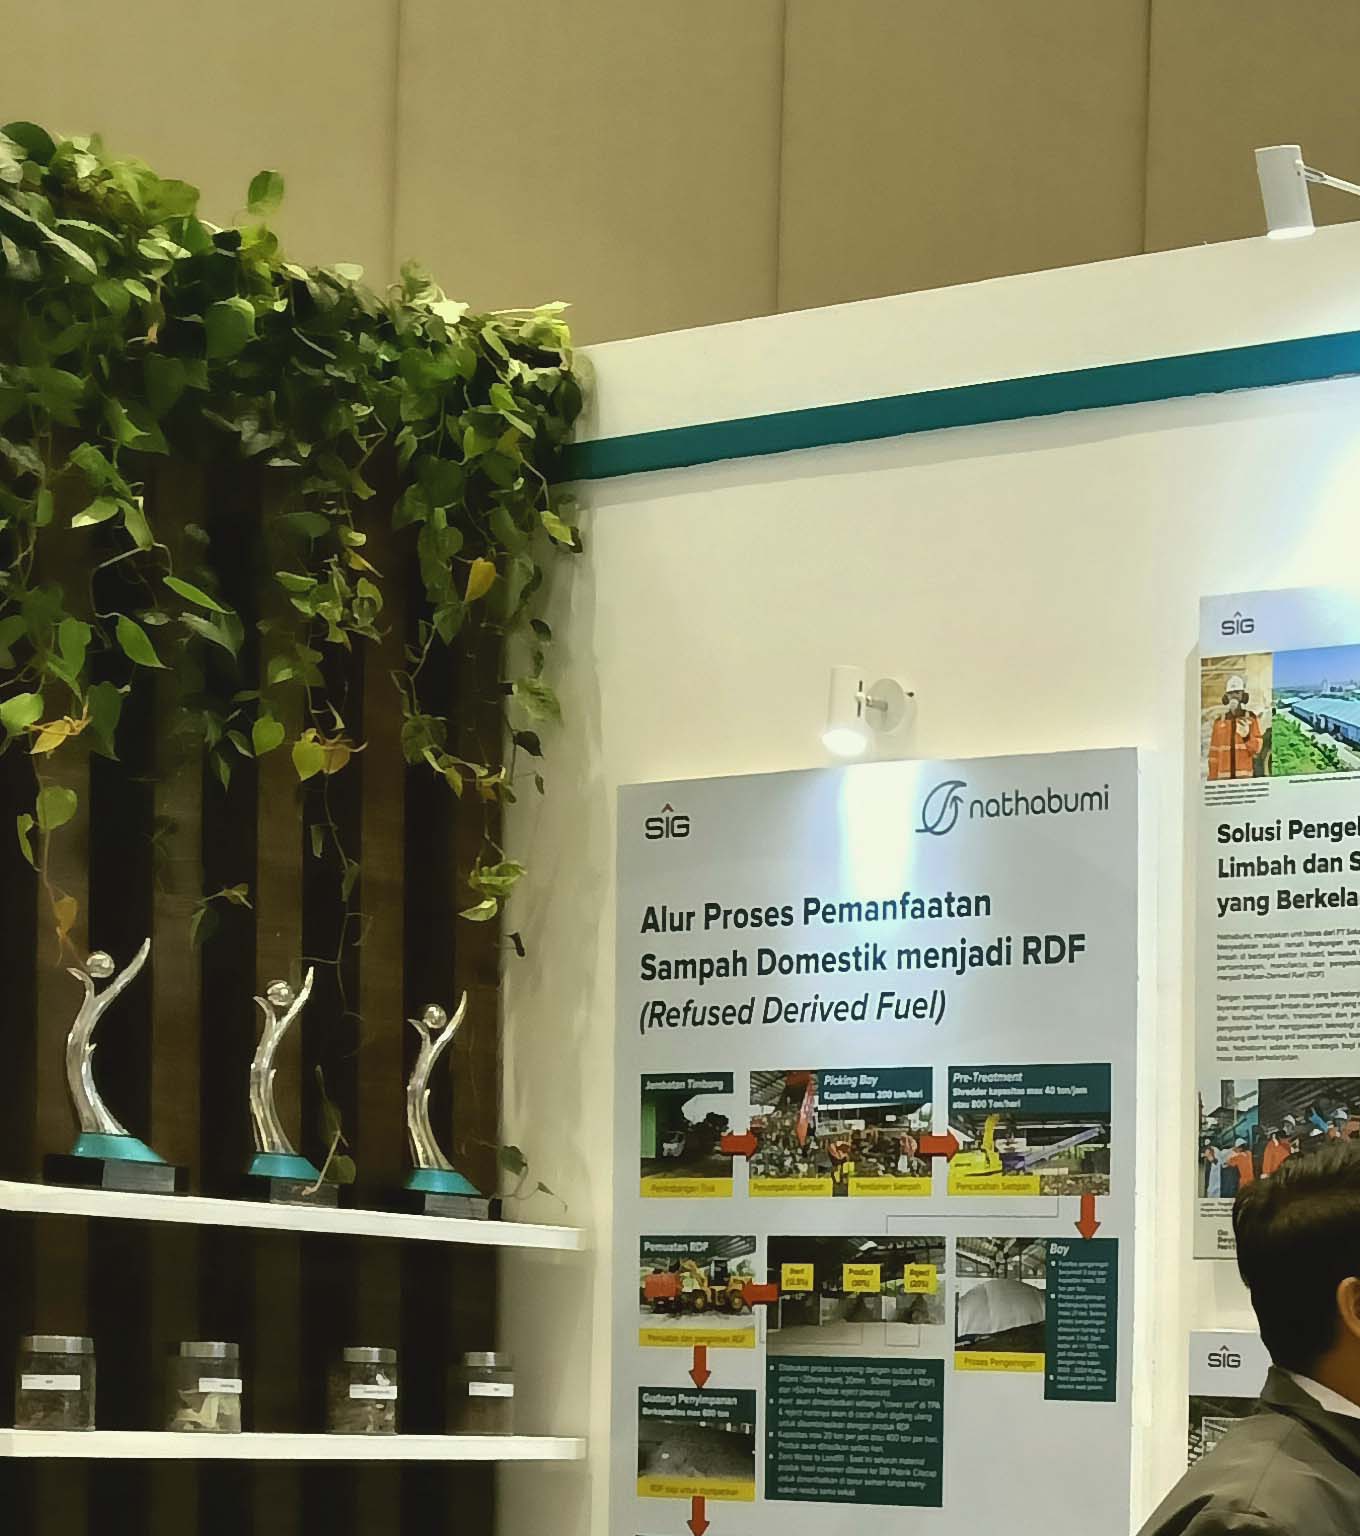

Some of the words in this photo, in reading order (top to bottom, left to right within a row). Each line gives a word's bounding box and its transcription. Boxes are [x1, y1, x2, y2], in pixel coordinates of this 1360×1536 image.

[1221, 612, 1254, 635] SIG
[970, 785, 1110, 820] nathabumi
[645, 804, 690, 840] SIG
[1217, 819, 1281, 843] Solusi
[1218, 853, 1296, 878] Limbah
[1303, 851, 1342, 874] dan
[641, 905, 695, 933] Alur
[704, 902, 794, 931] Proses
[803, 892, 991, 925] Pemanfaatan
[1217, 891, 1269, 917] yang
[640, 948, 747, 985] Sampah
[757, 943, 887, 976] Domestik
[897, 937, 1013, 974] menjadi
[1023, 934, 1086, 964] RDF
[640, 998, 755, 1034] (Refused
[762, 993, 868, 1025] Derived
[876, 990, 946, 1025] Fuel)
[1207, 1346, 1241, 1369] SIG
